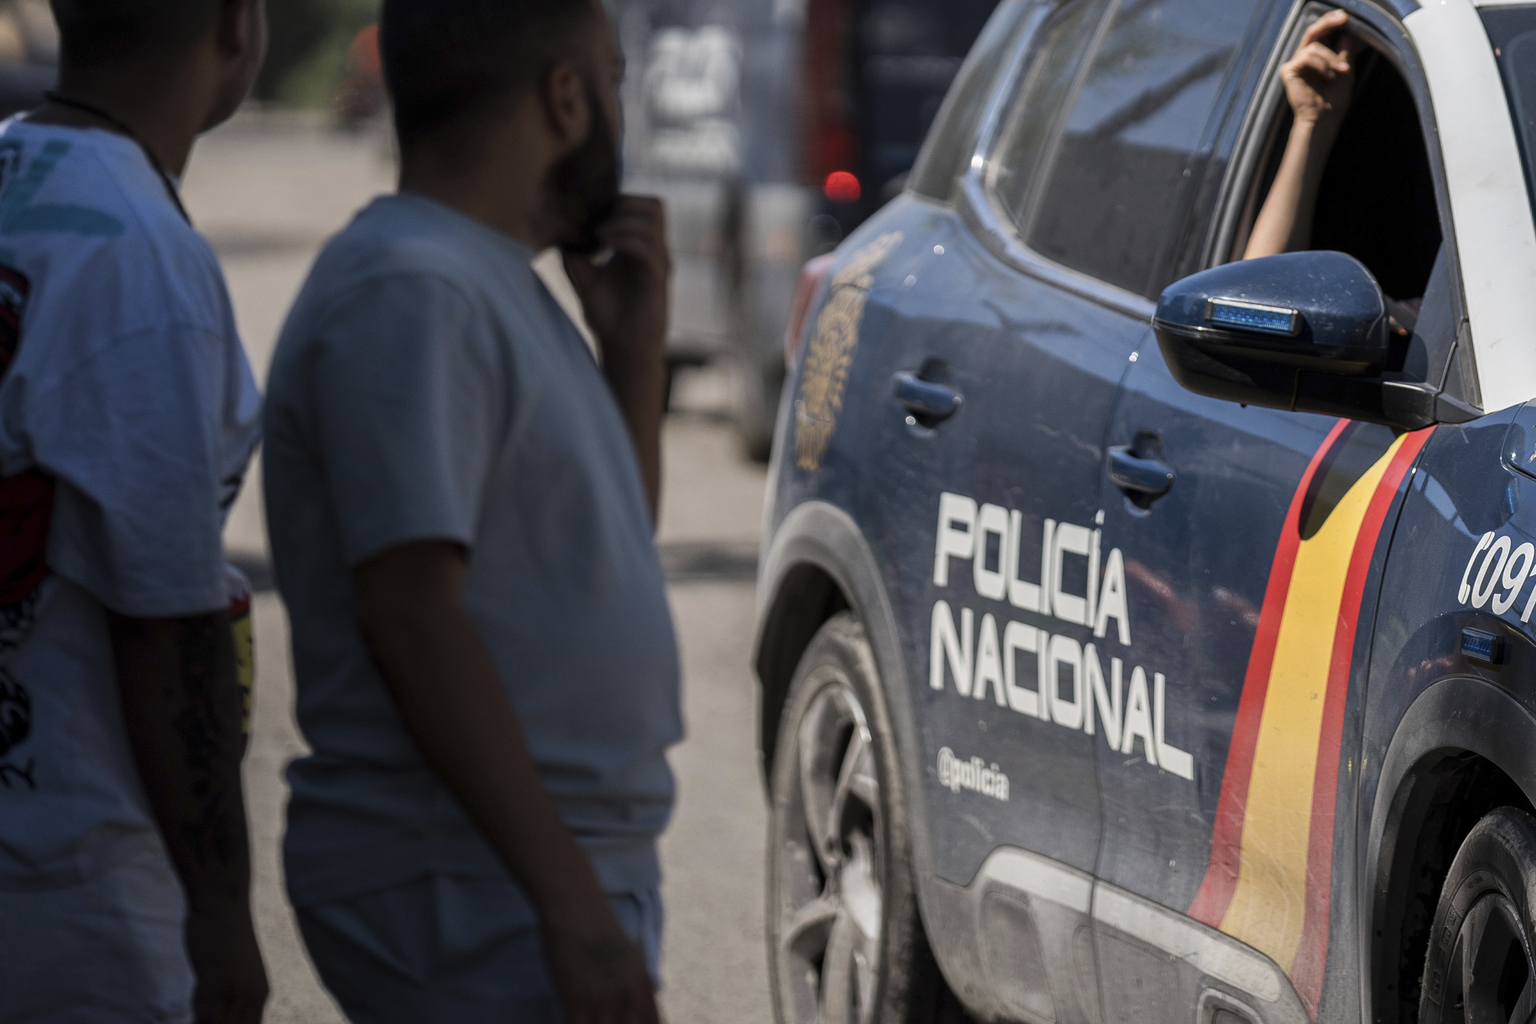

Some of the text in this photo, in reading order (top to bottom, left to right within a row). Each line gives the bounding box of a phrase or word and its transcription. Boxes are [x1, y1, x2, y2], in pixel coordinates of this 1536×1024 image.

[933, 491, 1131, 646] POLICÍA
[929, 599, 1194, 781] NACIONAL
[936, 745, 1010, 802] @policia
